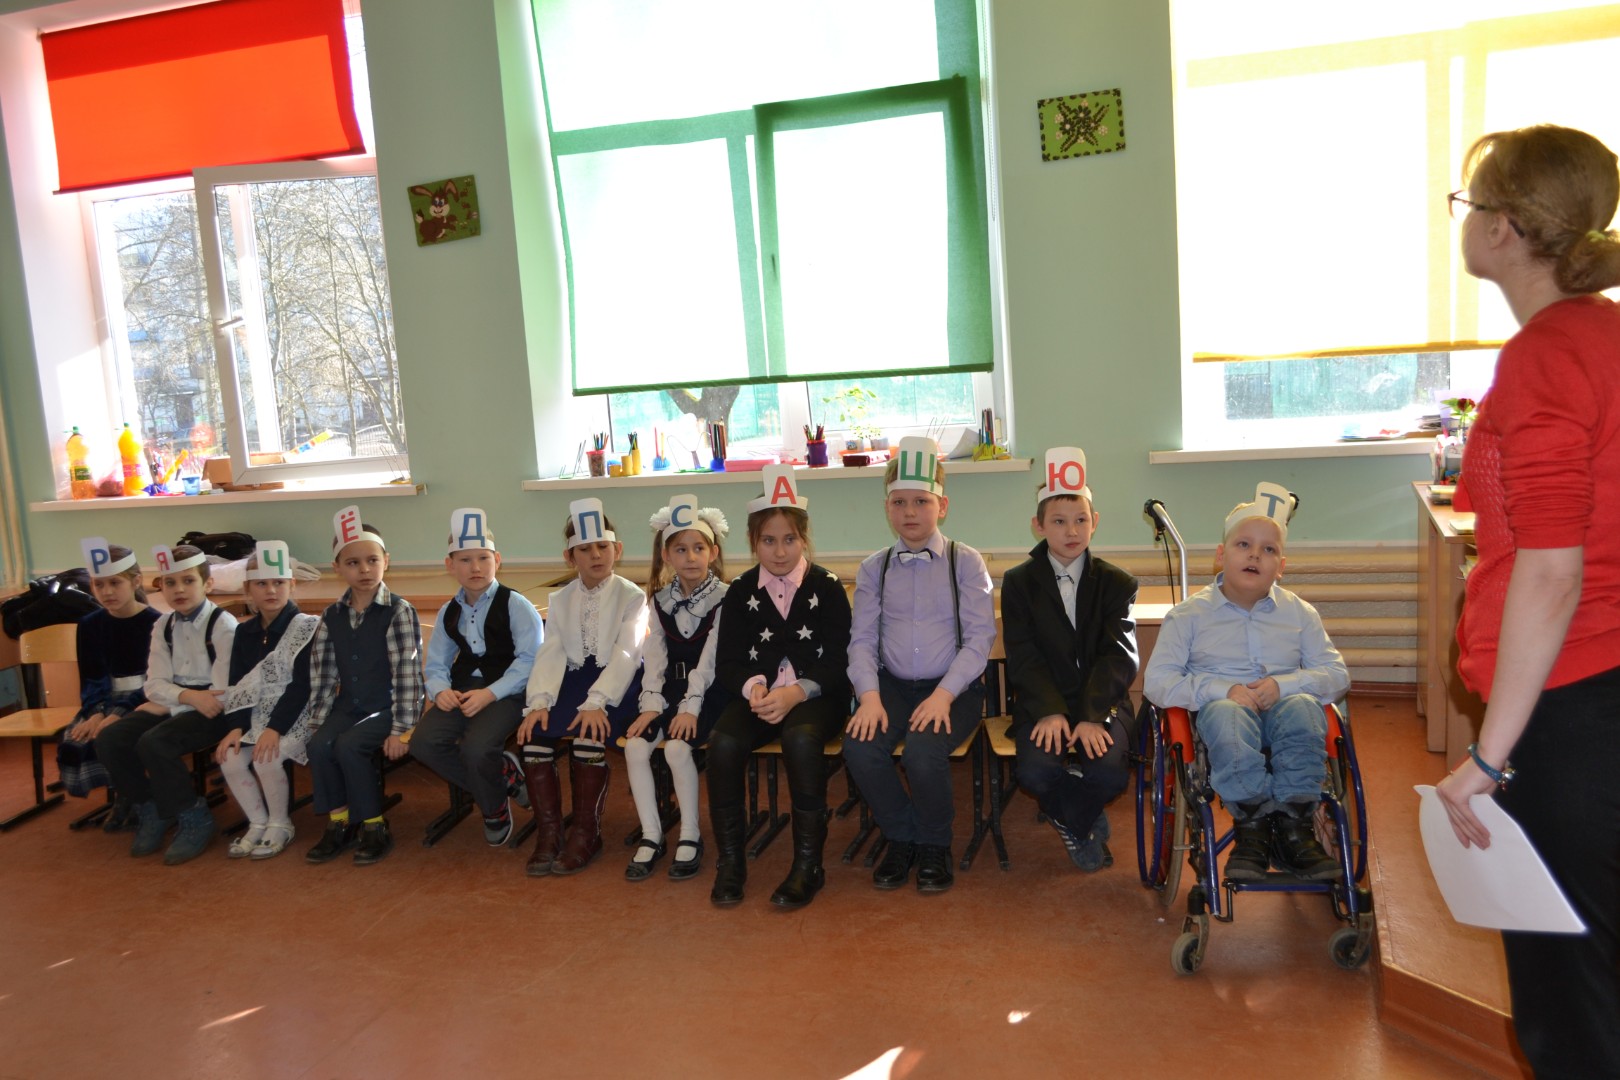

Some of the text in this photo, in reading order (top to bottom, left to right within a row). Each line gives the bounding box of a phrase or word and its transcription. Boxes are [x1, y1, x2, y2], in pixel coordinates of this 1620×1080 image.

[899, 450, 936, 491] Щ
[1048, 460, 1085, 493] Ю
[770, 475, 797, 504] А
[671, 504, 692, 528] С
[1260, 492, 1285, 518] Т
[340, 510, 359, 543] Ё
[458, 513, 486, 548] Д
[578, 510, 603, 541] П
[91, 549, 108, 574] Р
[263, 549, 284, 576] Ч
